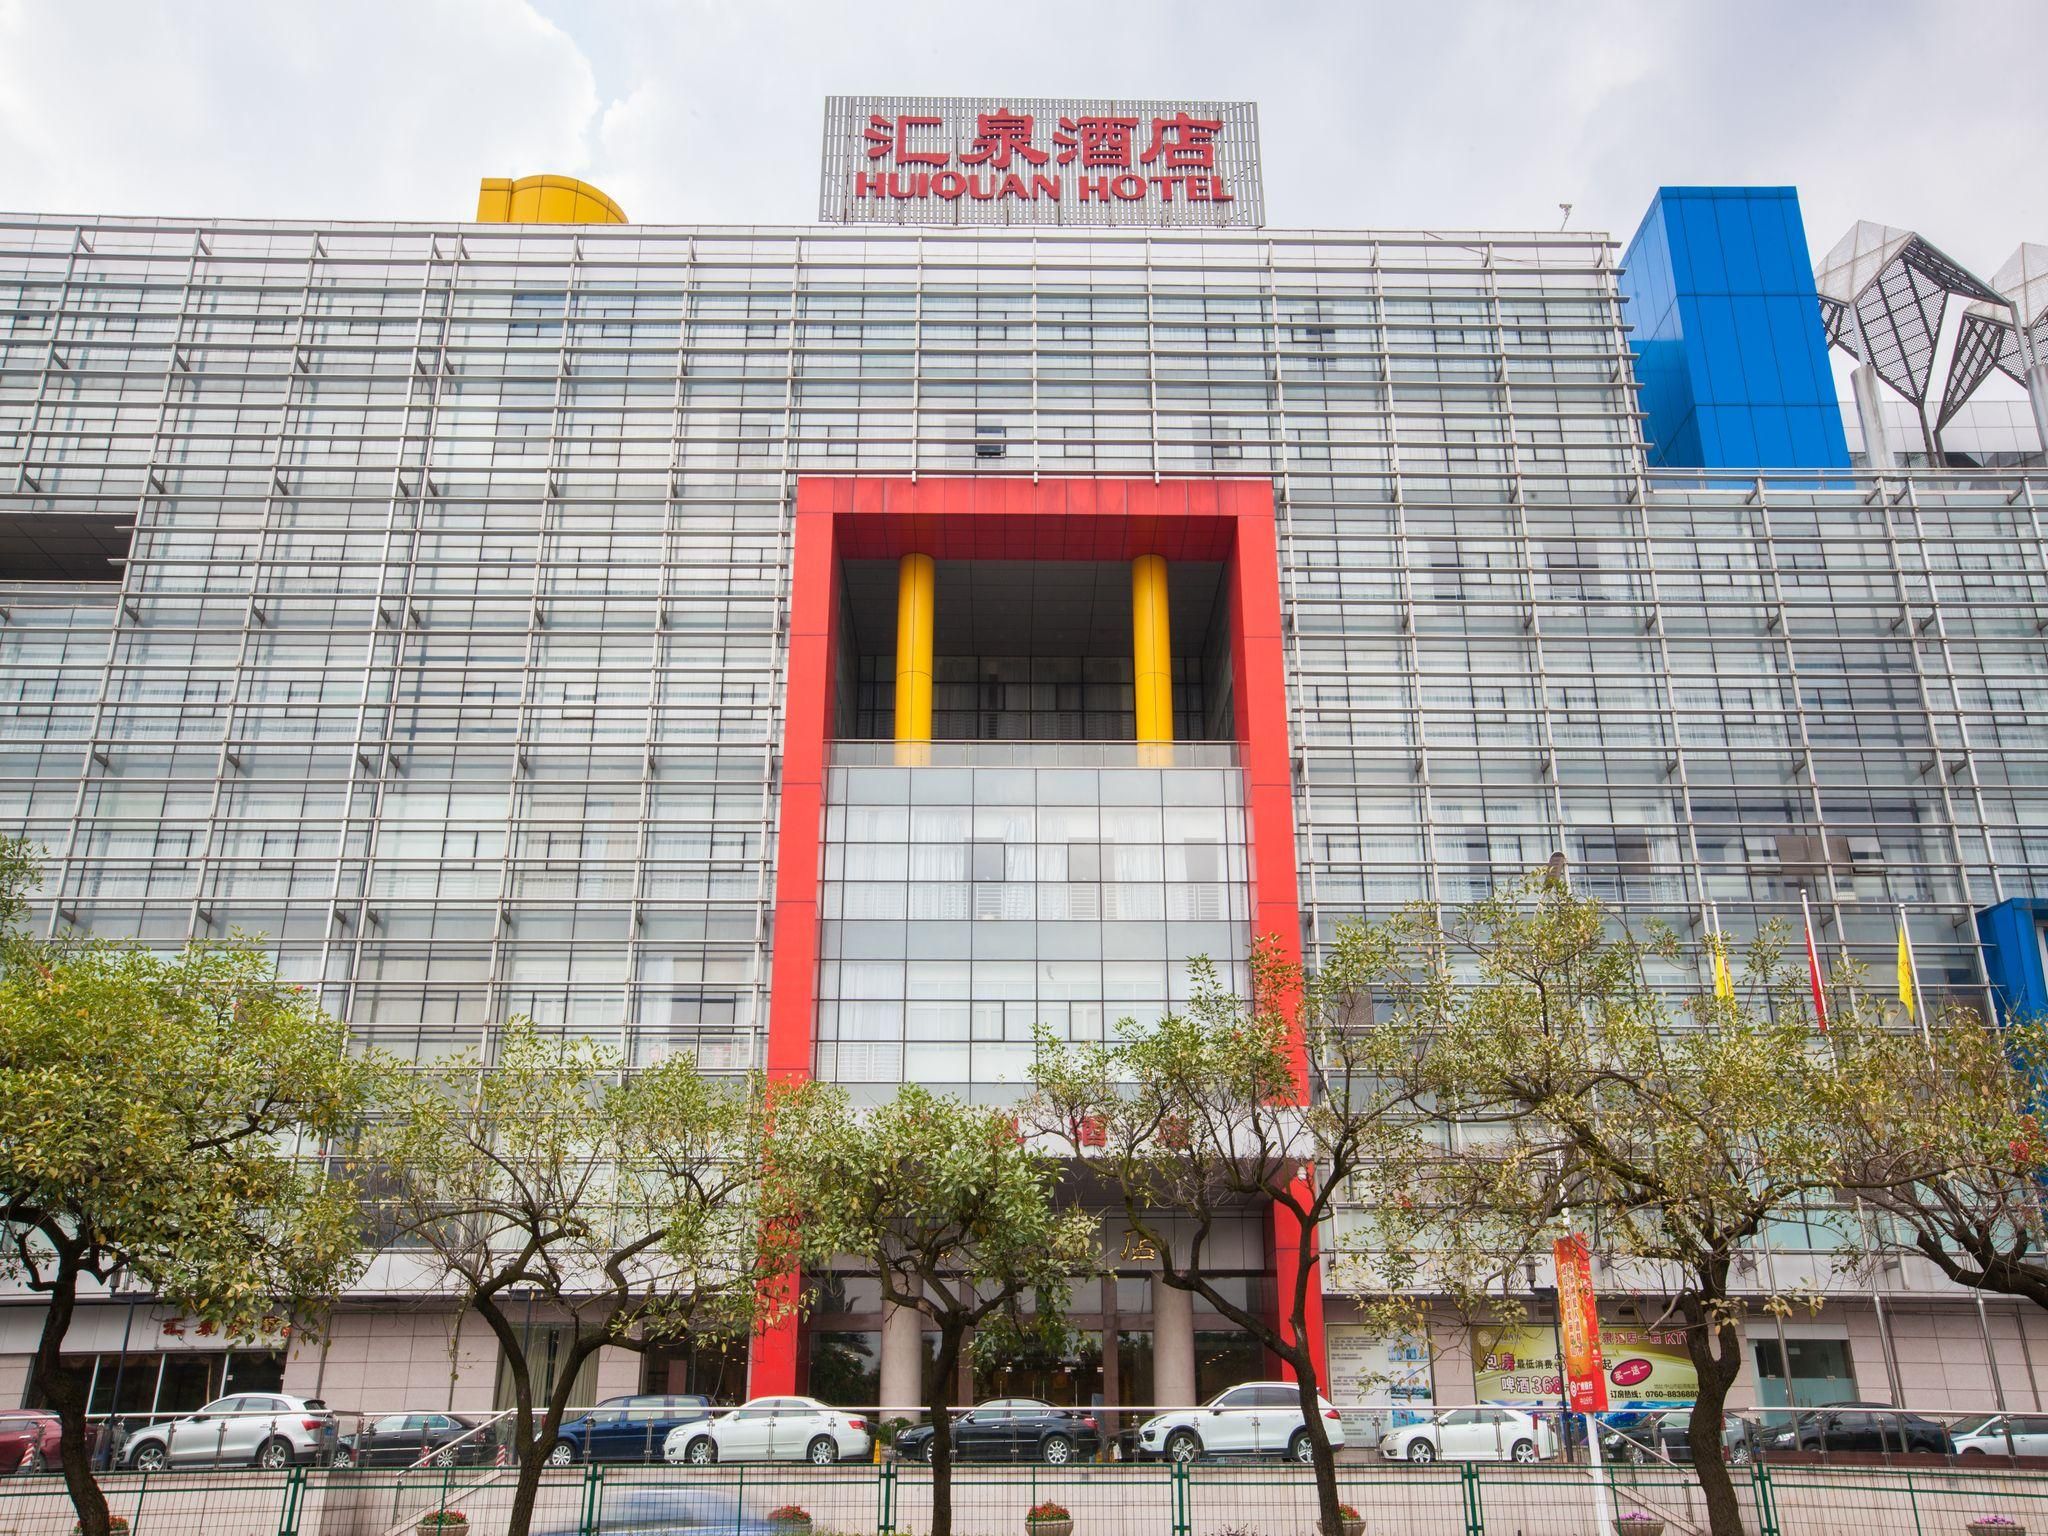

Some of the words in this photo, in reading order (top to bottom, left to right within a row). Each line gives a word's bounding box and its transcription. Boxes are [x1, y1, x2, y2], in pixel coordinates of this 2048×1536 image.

[864, 107, 1224, 169] 汇泉酒店
[855, 171, 1061, 202] HUIQUAN
[1078, 174, 1235, 202] HOTEL
[1614, 1365, 1648, 1381] 买一送一
